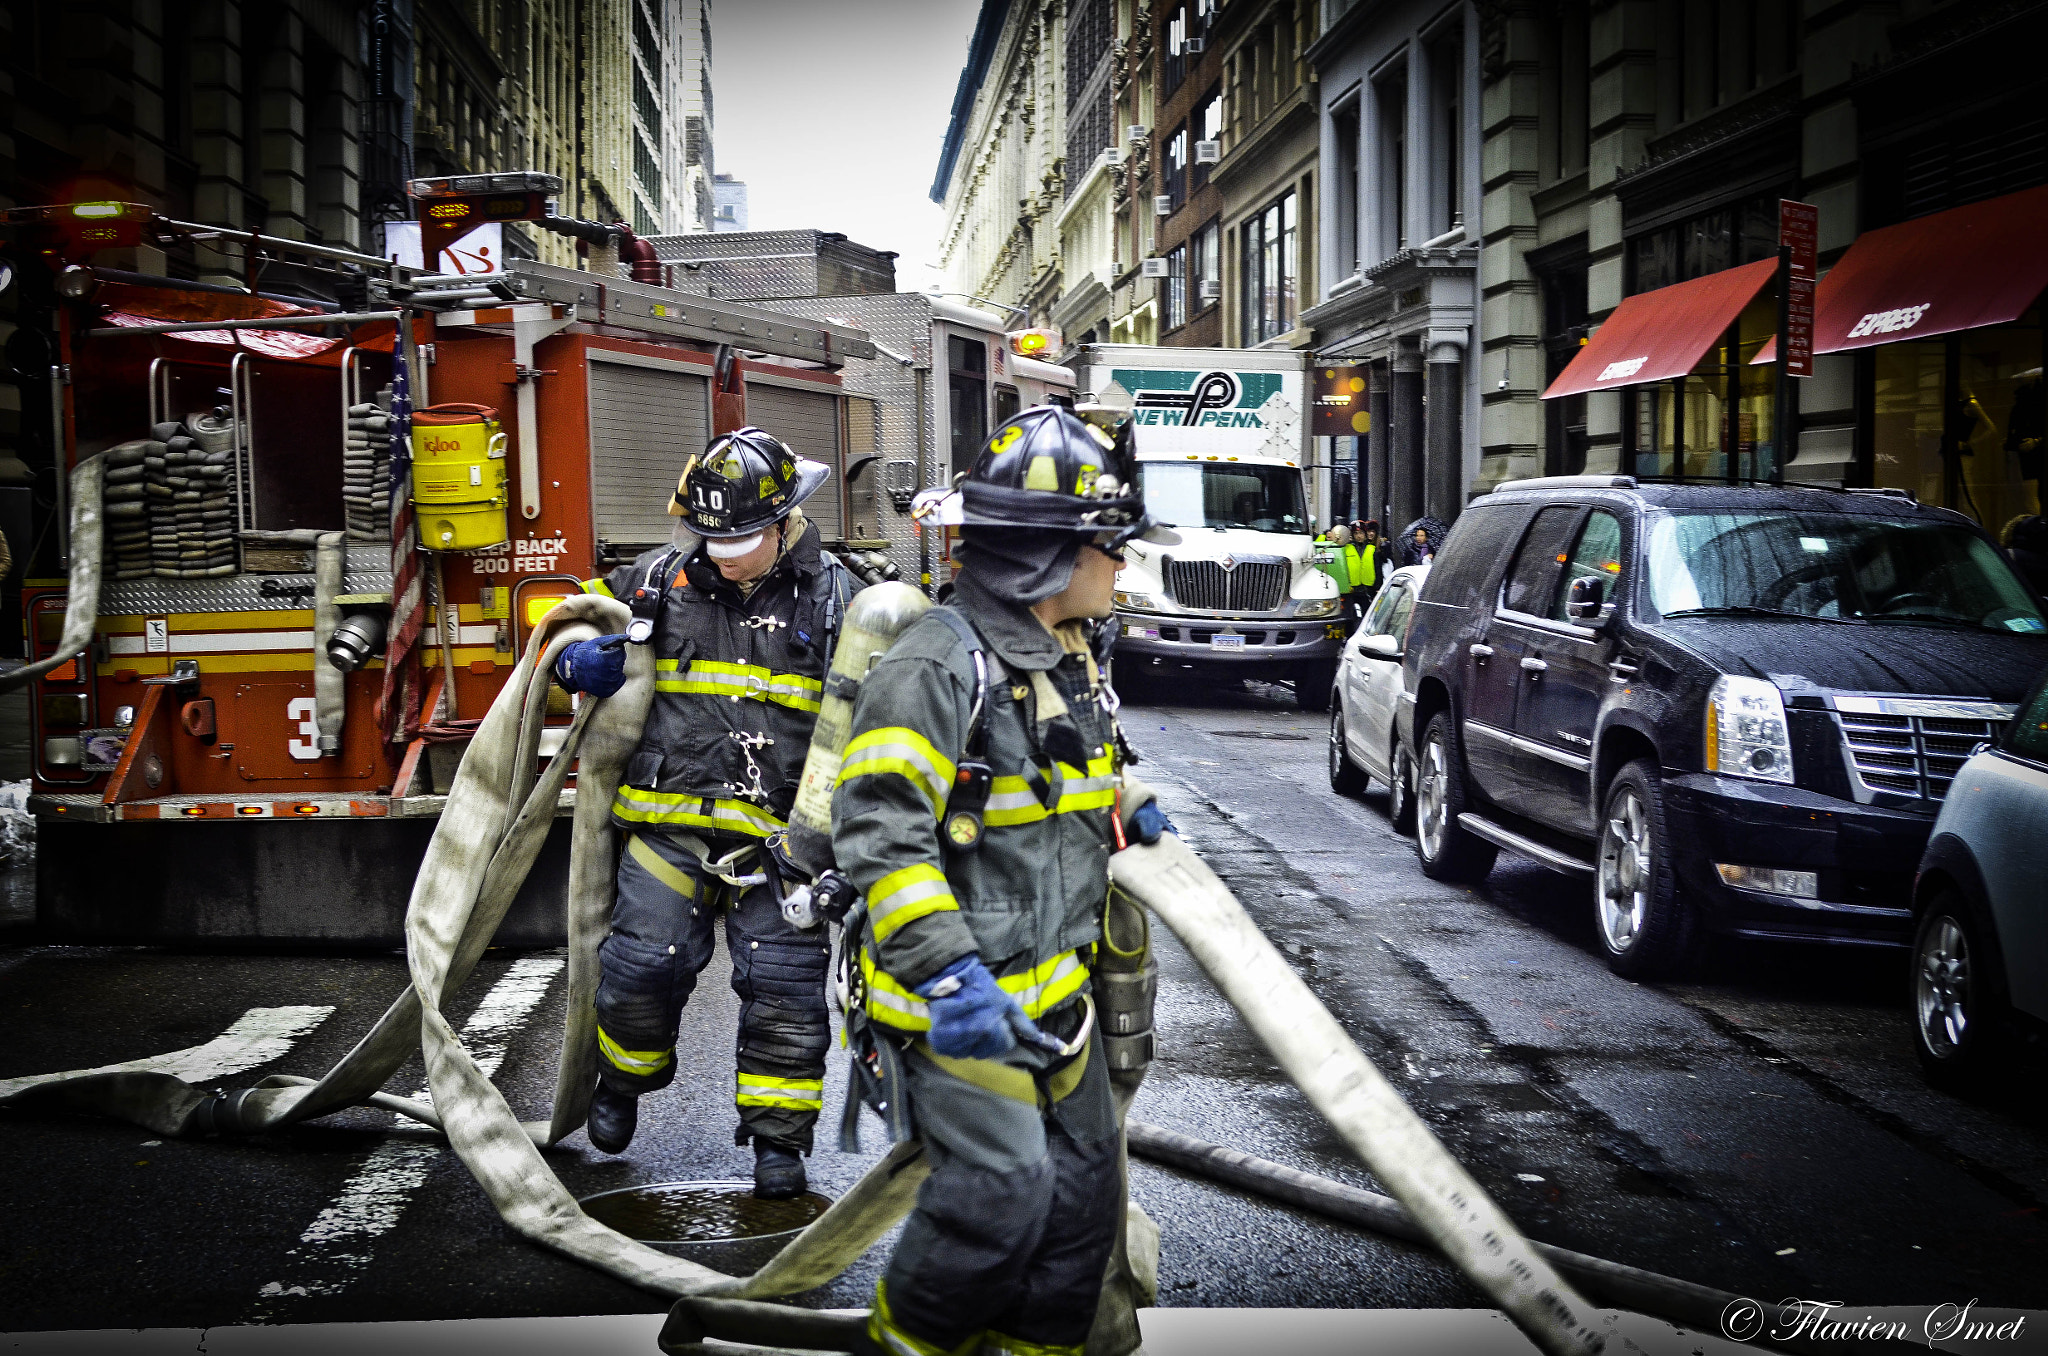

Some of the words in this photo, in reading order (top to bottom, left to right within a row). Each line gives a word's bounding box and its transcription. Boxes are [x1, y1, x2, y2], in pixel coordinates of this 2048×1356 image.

[1846, 302, 1931, 338] EXPRESS
[1133, 409, 1184, 427] NEW
[423, 436, 461, 457] igloo
[990, 425, 1024, 454] 3
[696, 486, 723, 511] 10
[515, 538, 569, 556] BACK
[472, 558, 510, 574] 200
[513, 555, 559, 573] FEET
[287, 697, 323, 760] 3
